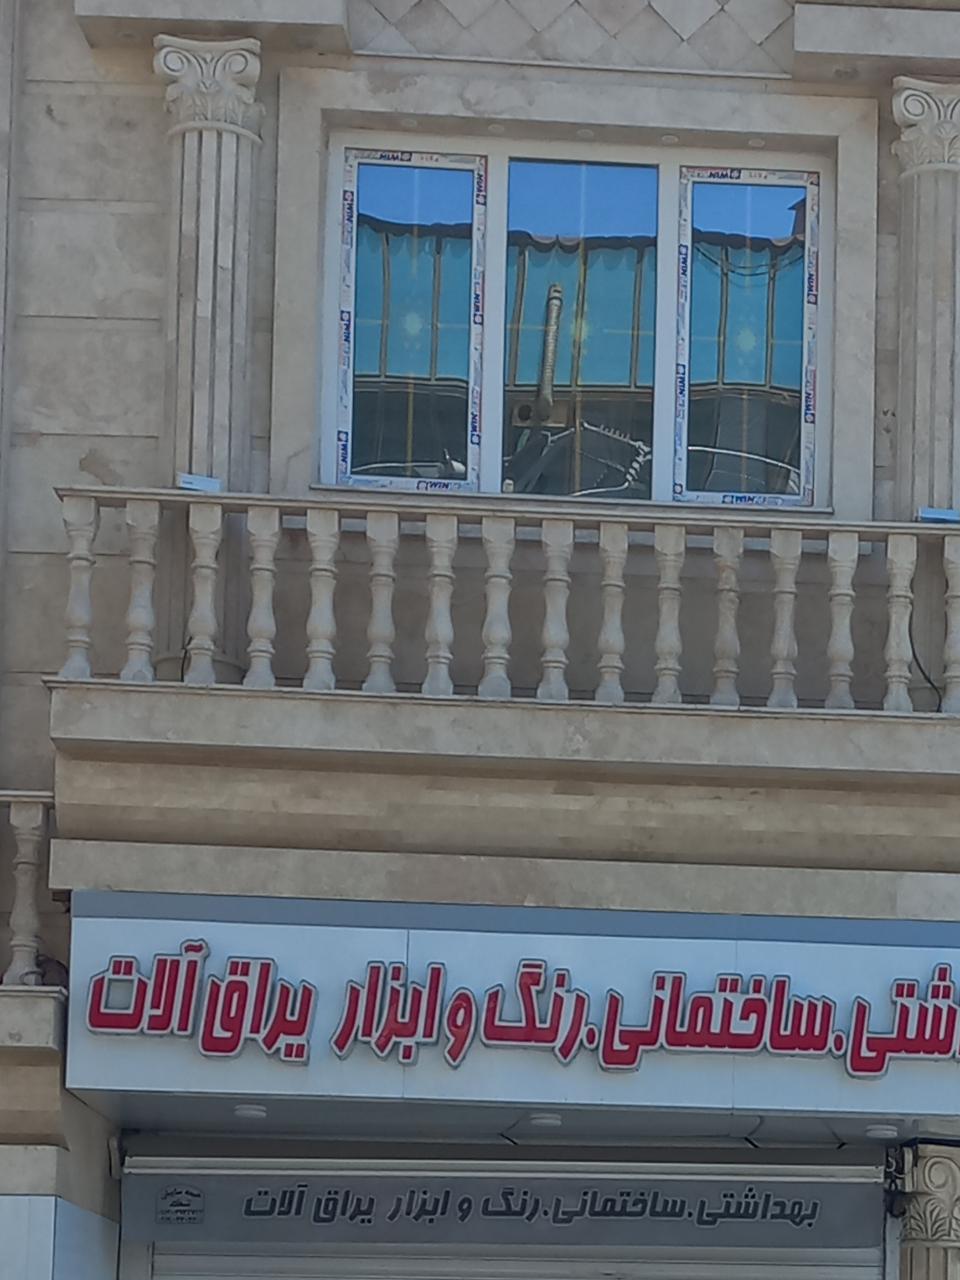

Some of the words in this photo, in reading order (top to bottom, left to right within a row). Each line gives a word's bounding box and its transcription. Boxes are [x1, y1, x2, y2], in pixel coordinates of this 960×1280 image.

[331, 961, 445, 1063] ابزار
[444, 988, 477, 1068] و
[386, 1189, 451, 1224] ابزار
[457, 1196, 473, 1222] و
